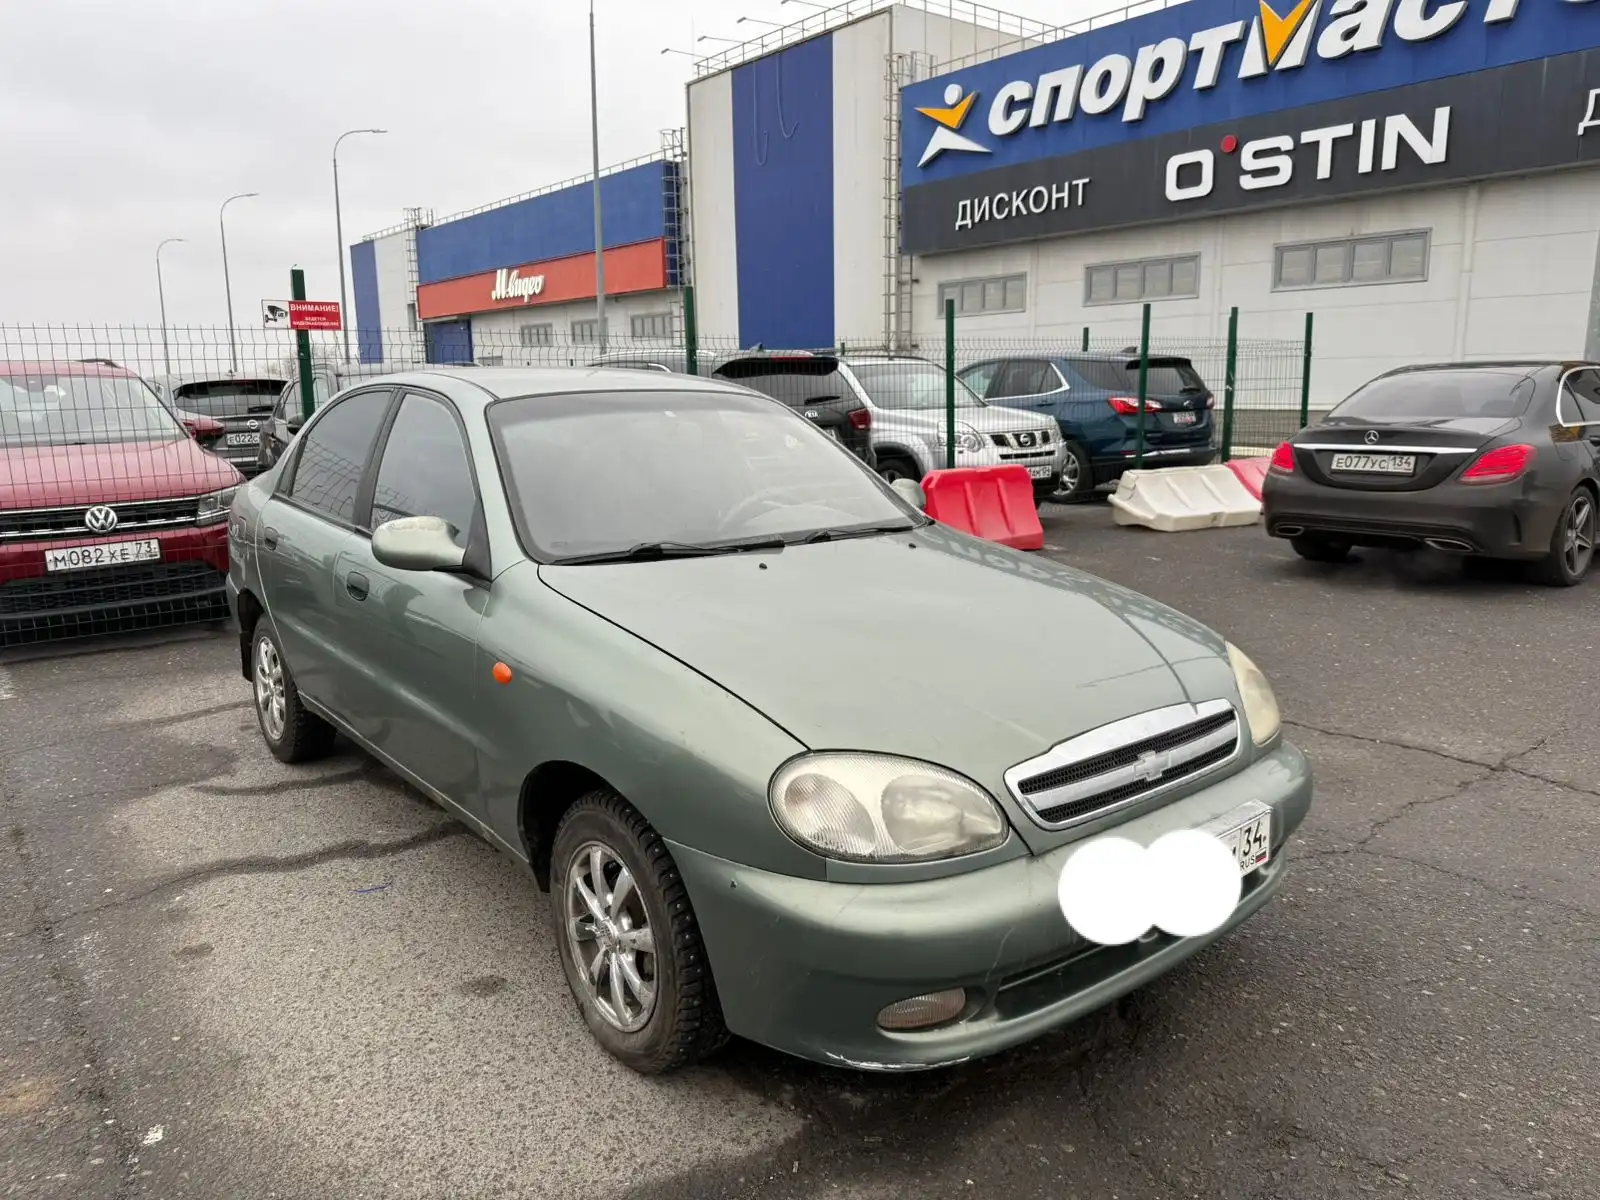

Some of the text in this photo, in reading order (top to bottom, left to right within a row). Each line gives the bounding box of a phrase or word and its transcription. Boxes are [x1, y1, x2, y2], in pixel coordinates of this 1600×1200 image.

[955, 177, 1090, 231] ДИСКОНТ
[290, 303, 339, 312] ВНИМАНИЕ!
[229, 434, 259, 444] Е022С
[1243, 821, 1262, 856] 34
[1240, 854, 1255, 869] RUS
